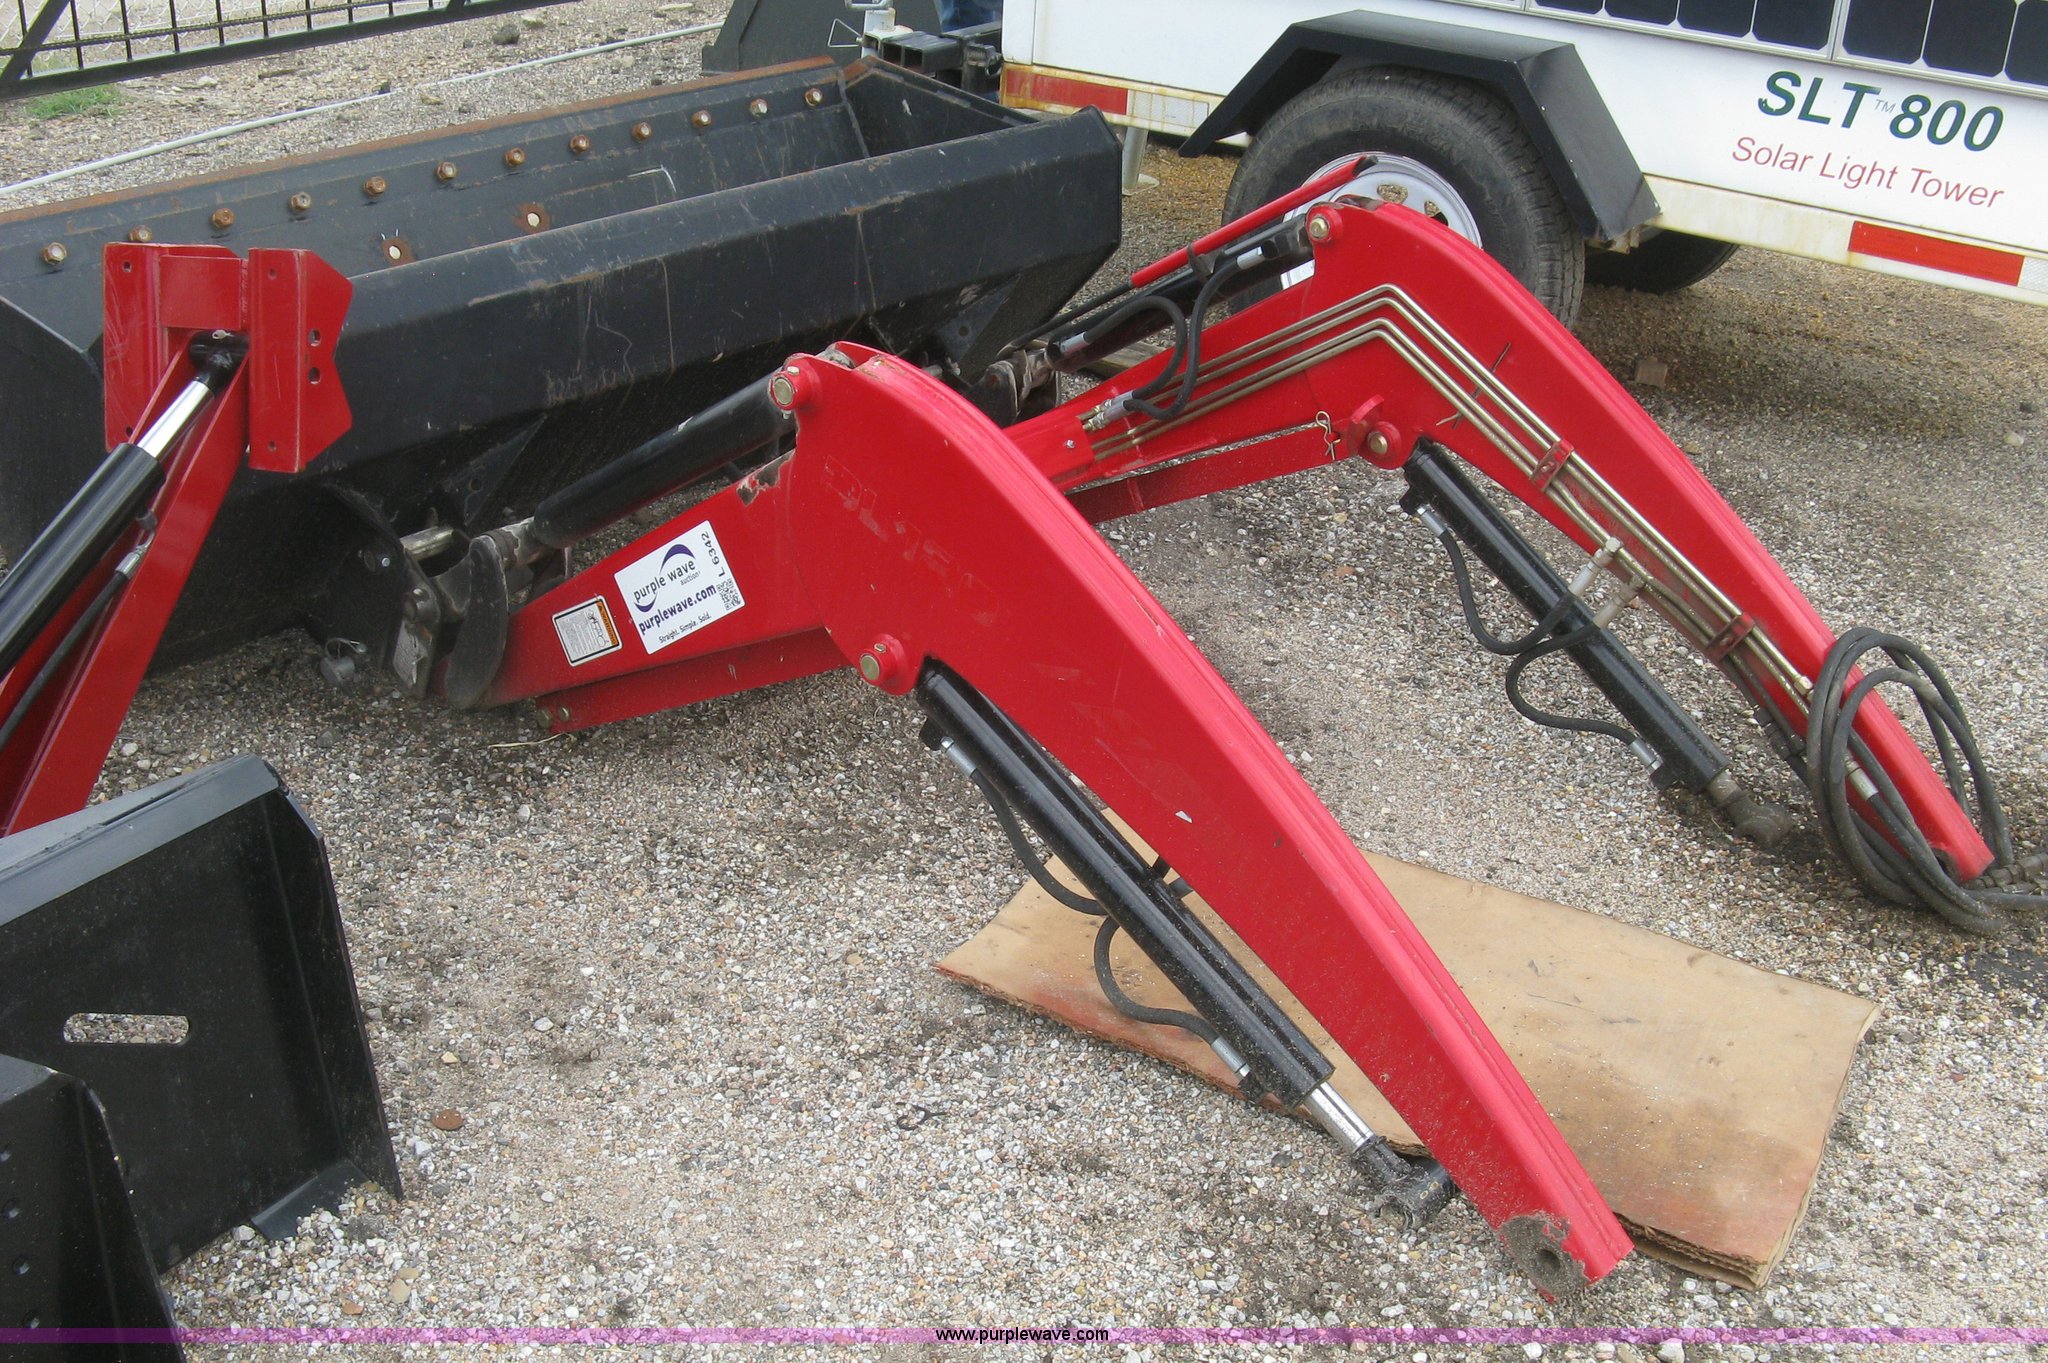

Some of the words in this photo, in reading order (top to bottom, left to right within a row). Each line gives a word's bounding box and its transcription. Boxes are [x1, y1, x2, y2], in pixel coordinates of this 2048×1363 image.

[1757, 70, 1882, 128] SLT
[1889, 94, 2005, 152] 800
[1731, 136, 1814, 173] Solar
[1819, 152, 1899, 190] Light
[1909, 168, 2005, 208] Tower
[701, 531, 720, 565] 6342
[633, 576, 666, 603] purple
[667, 559, 696, 582] wave
[638, 583, 717, 636] purplewave.com
